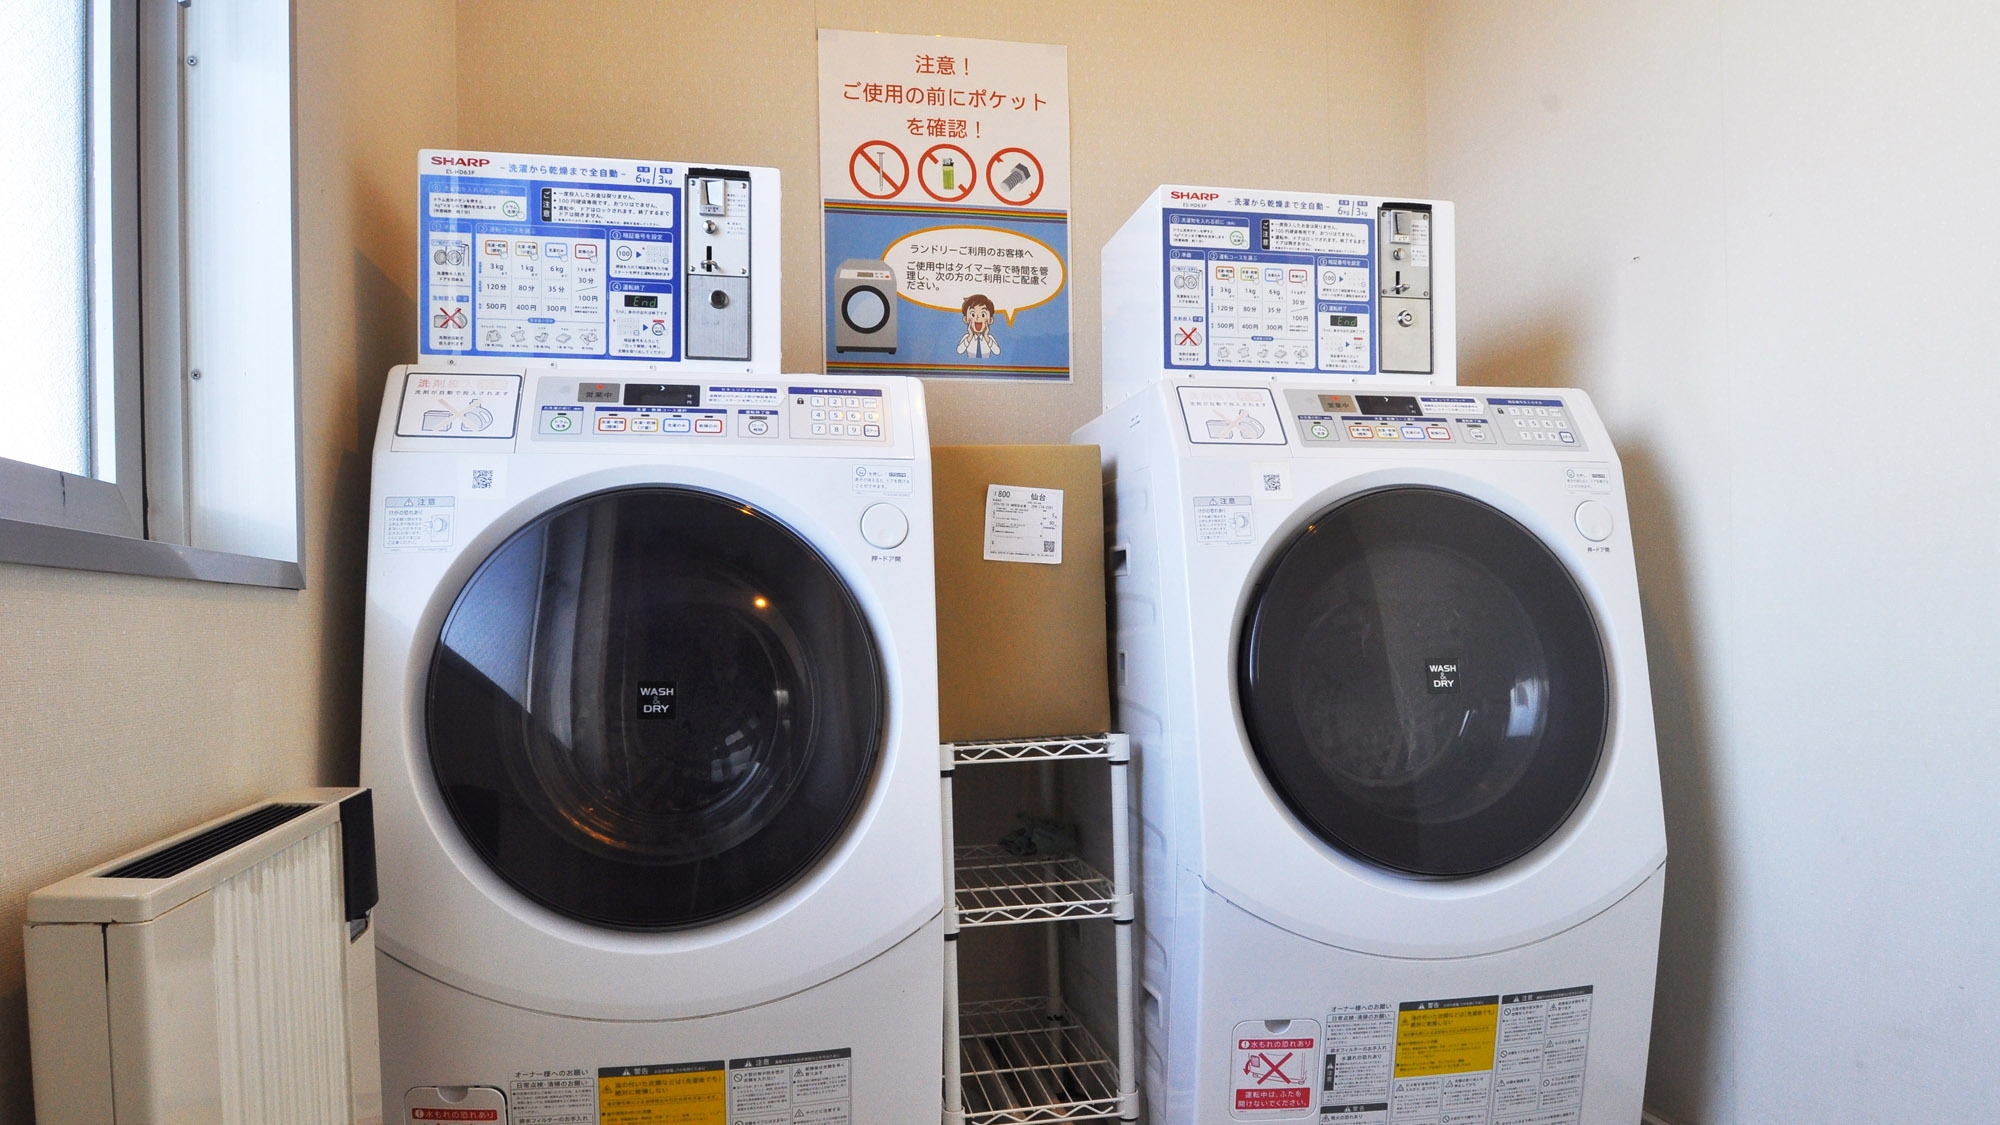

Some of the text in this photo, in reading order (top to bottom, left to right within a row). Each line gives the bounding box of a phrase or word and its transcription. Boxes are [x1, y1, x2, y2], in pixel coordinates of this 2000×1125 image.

[915, 54, 970, 76] 注意！
[843, 81, 1047, 112] ご使用の前にポケット
[906, 117, 981, 139] を確認！
[431, 156, 490, 167] SHARP
[1170, 191, 1219, 201] SHARP
[910, 244, 1034, 259] ランドリーご利用のお客様へ
[906, 261, 1049, 276] ご使用中はタイマー等で時間を管
[906, 271, 1048, 286] 理し、次の方のご利用にご配慮く
[906, 280, 940, 292] ださい。
[633, 296, 657, 307] End
[1337, 316, 1357, 326] End
[997, 490, 1011, 498] 800
[1030, 493, 1047, 502] 仙台
[1429, 664, 1457, 673] WASH
[1439, 671, 1447, 680] &
[1433, 679, 1455, 688] DRY
[640, 687, 674, 696] WASH
[643, 704, 670, 713] DRY
[1237, 1099, 1307, 1107] 開けないでください。
